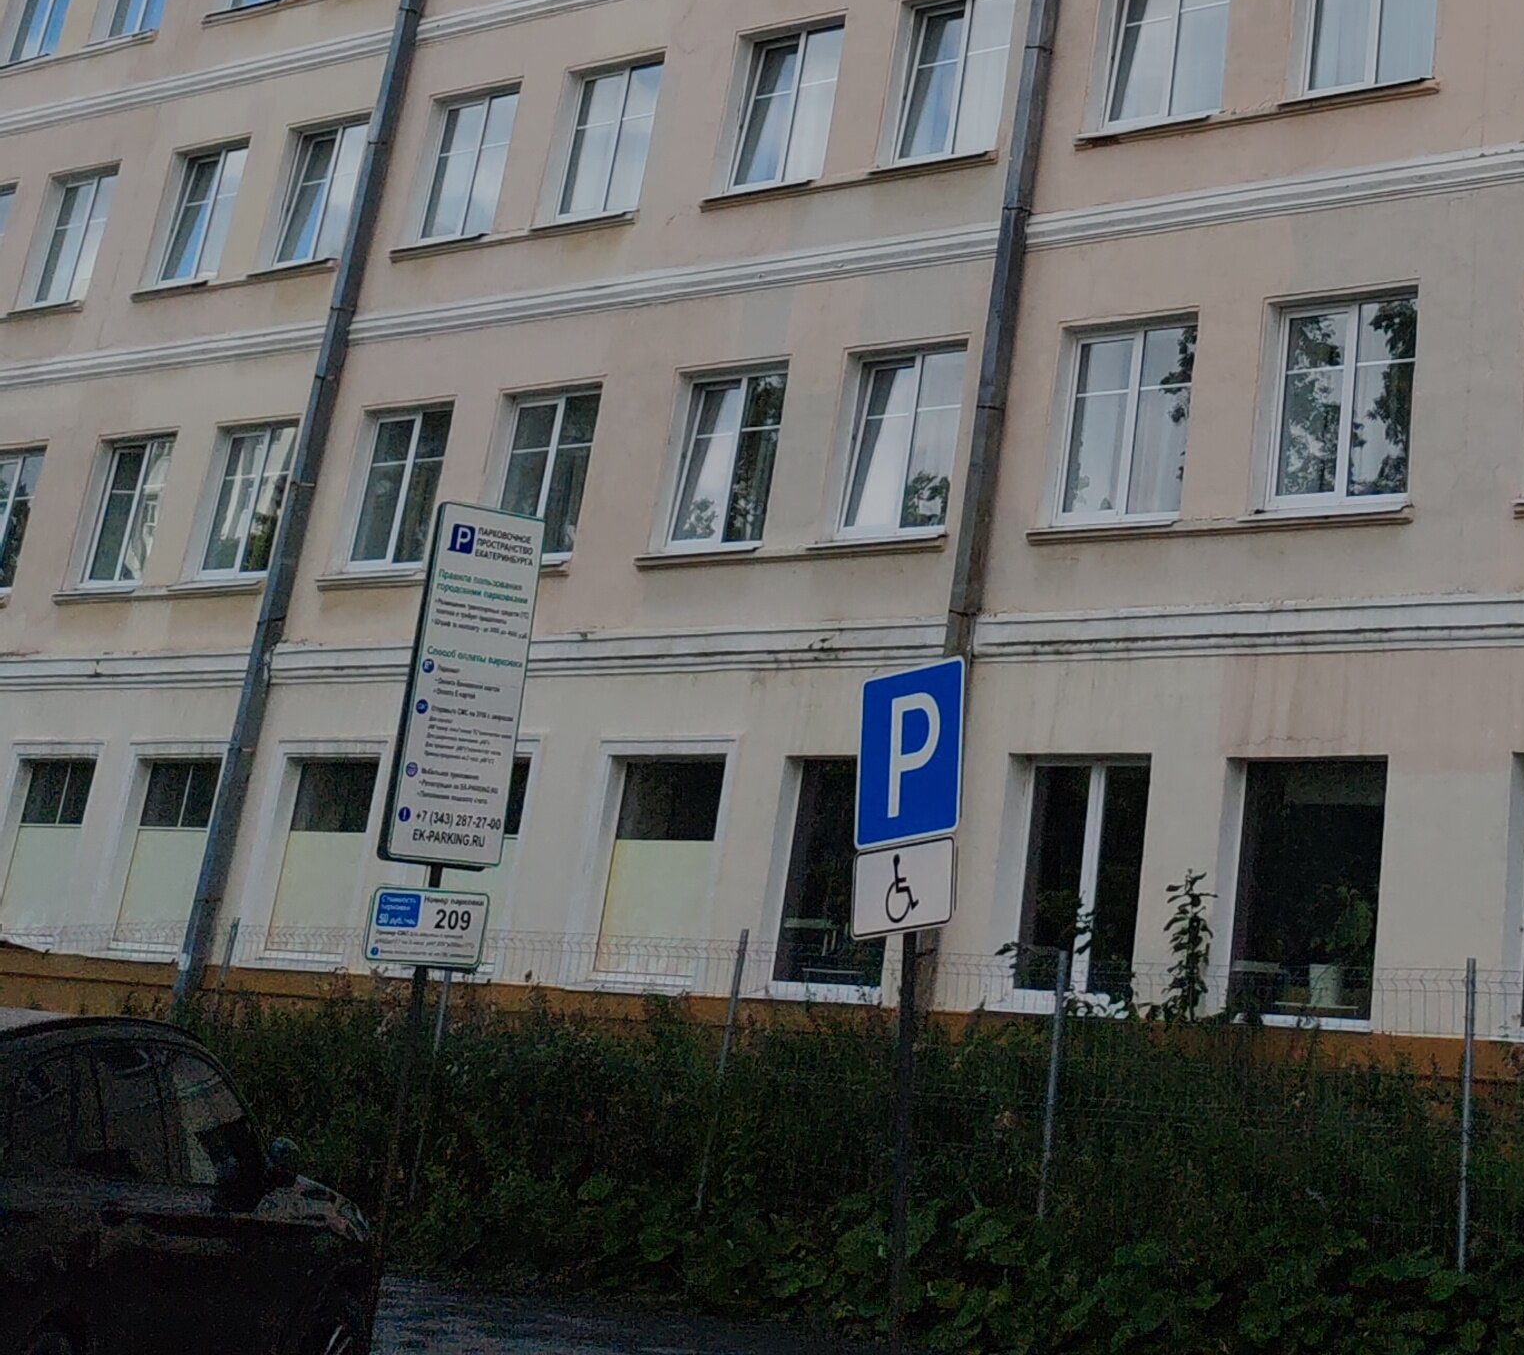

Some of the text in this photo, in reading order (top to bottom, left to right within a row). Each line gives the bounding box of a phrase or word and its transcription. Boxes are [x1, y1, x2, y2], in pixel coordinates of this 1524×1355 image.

[478, 527, 532, 544] ПАРКОВОЧНОЕ
[476, 538, 534, 556] ПРОСТРАНСТВО
[475, 550, 534, 566] ЕКАТЕРИНБУРГА
[427, 645, 456, 658] Способ
[887, 692, 940, 819] P
[416, 810, 502, 831] +7 (343) 287-27-00
[412, 829, 486, 848] EK-PARKING.RU
[433, 908, 472, 931] 209
